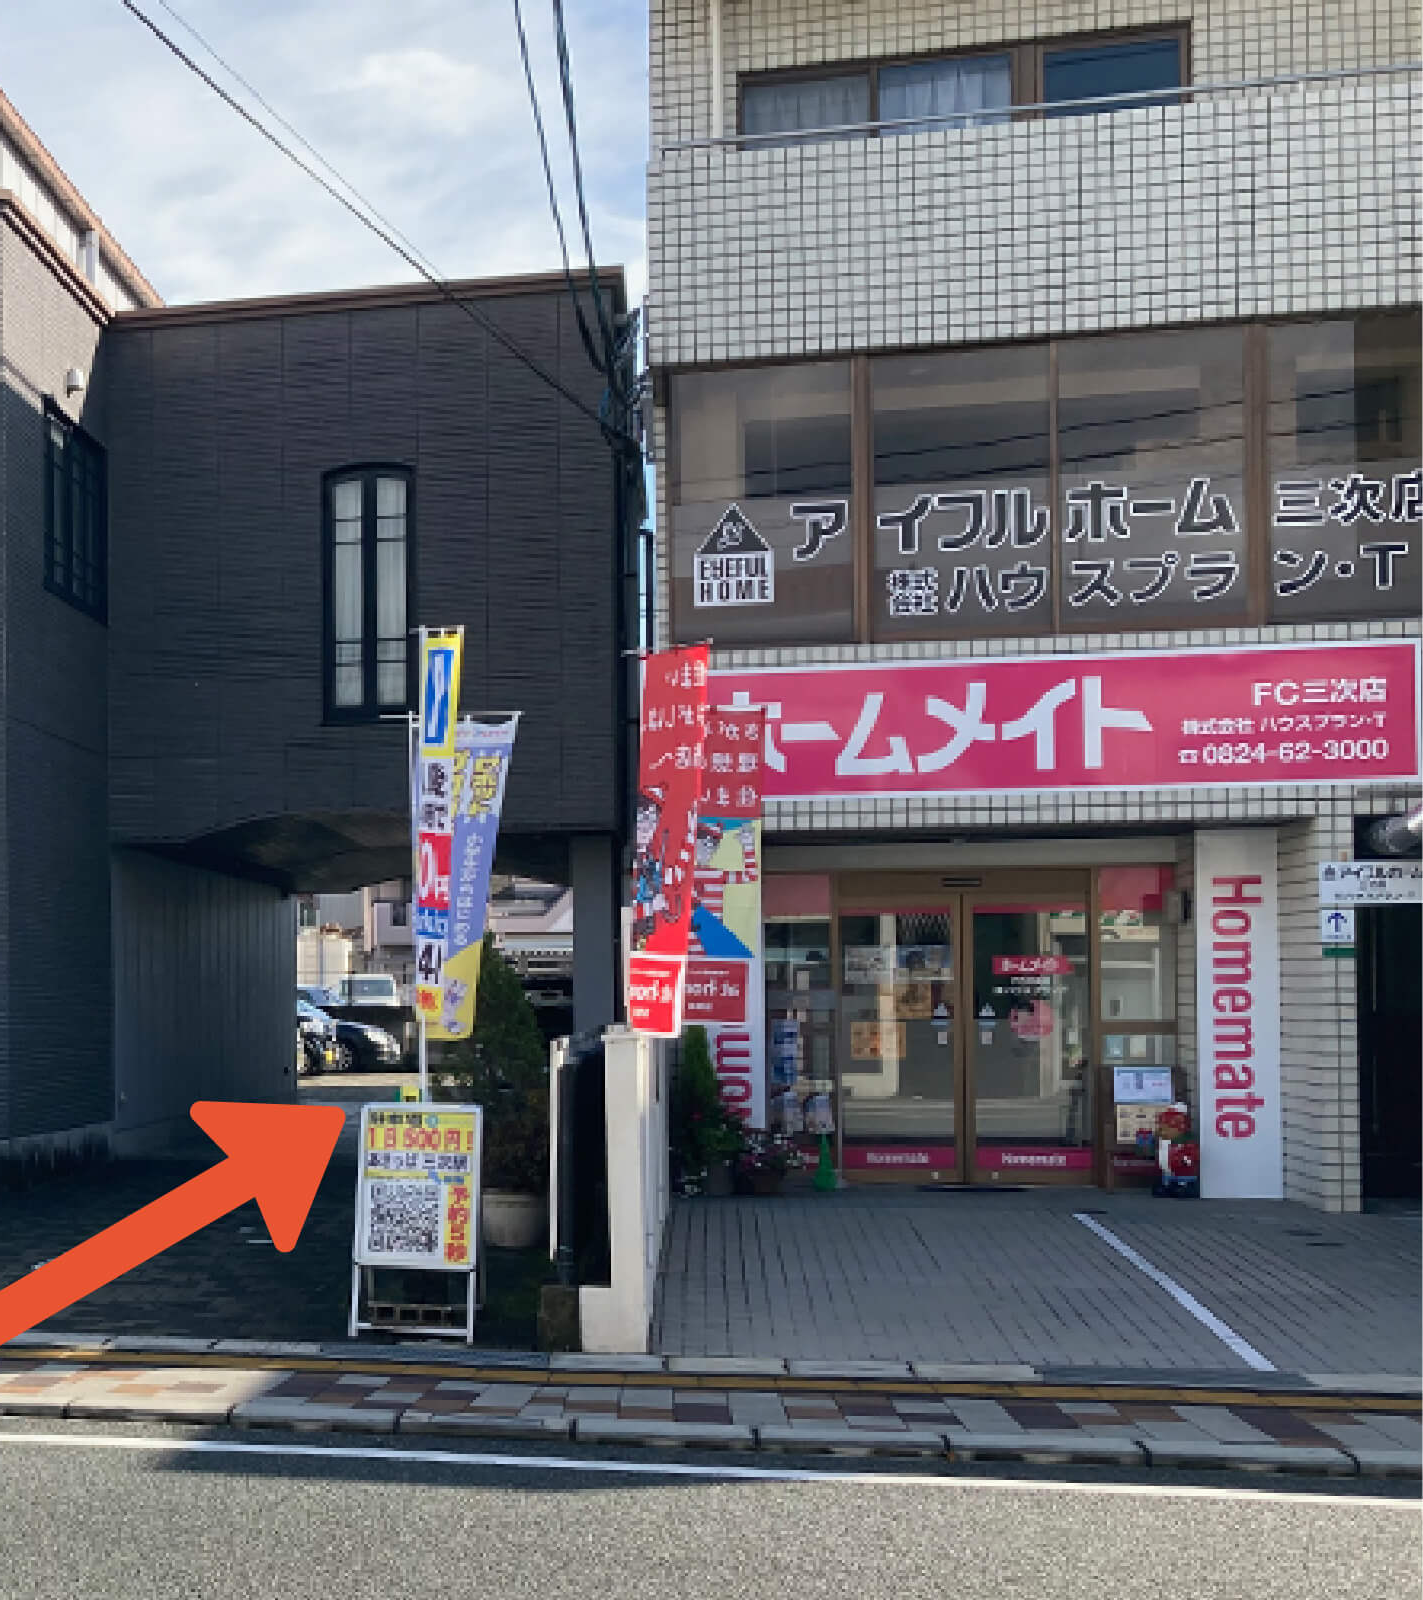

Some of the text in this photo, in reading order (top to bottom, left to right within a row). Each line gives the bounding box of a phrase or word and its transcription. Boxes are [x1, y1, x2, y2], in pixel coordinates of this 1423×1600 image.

[699, 579, 770, 602] HOME
[1252, 676, 1387, 706] FC三次店
[1202, 736, 1390, 766] 0824-62-3000
[1210, 874, 1265, 1140] Homemate
